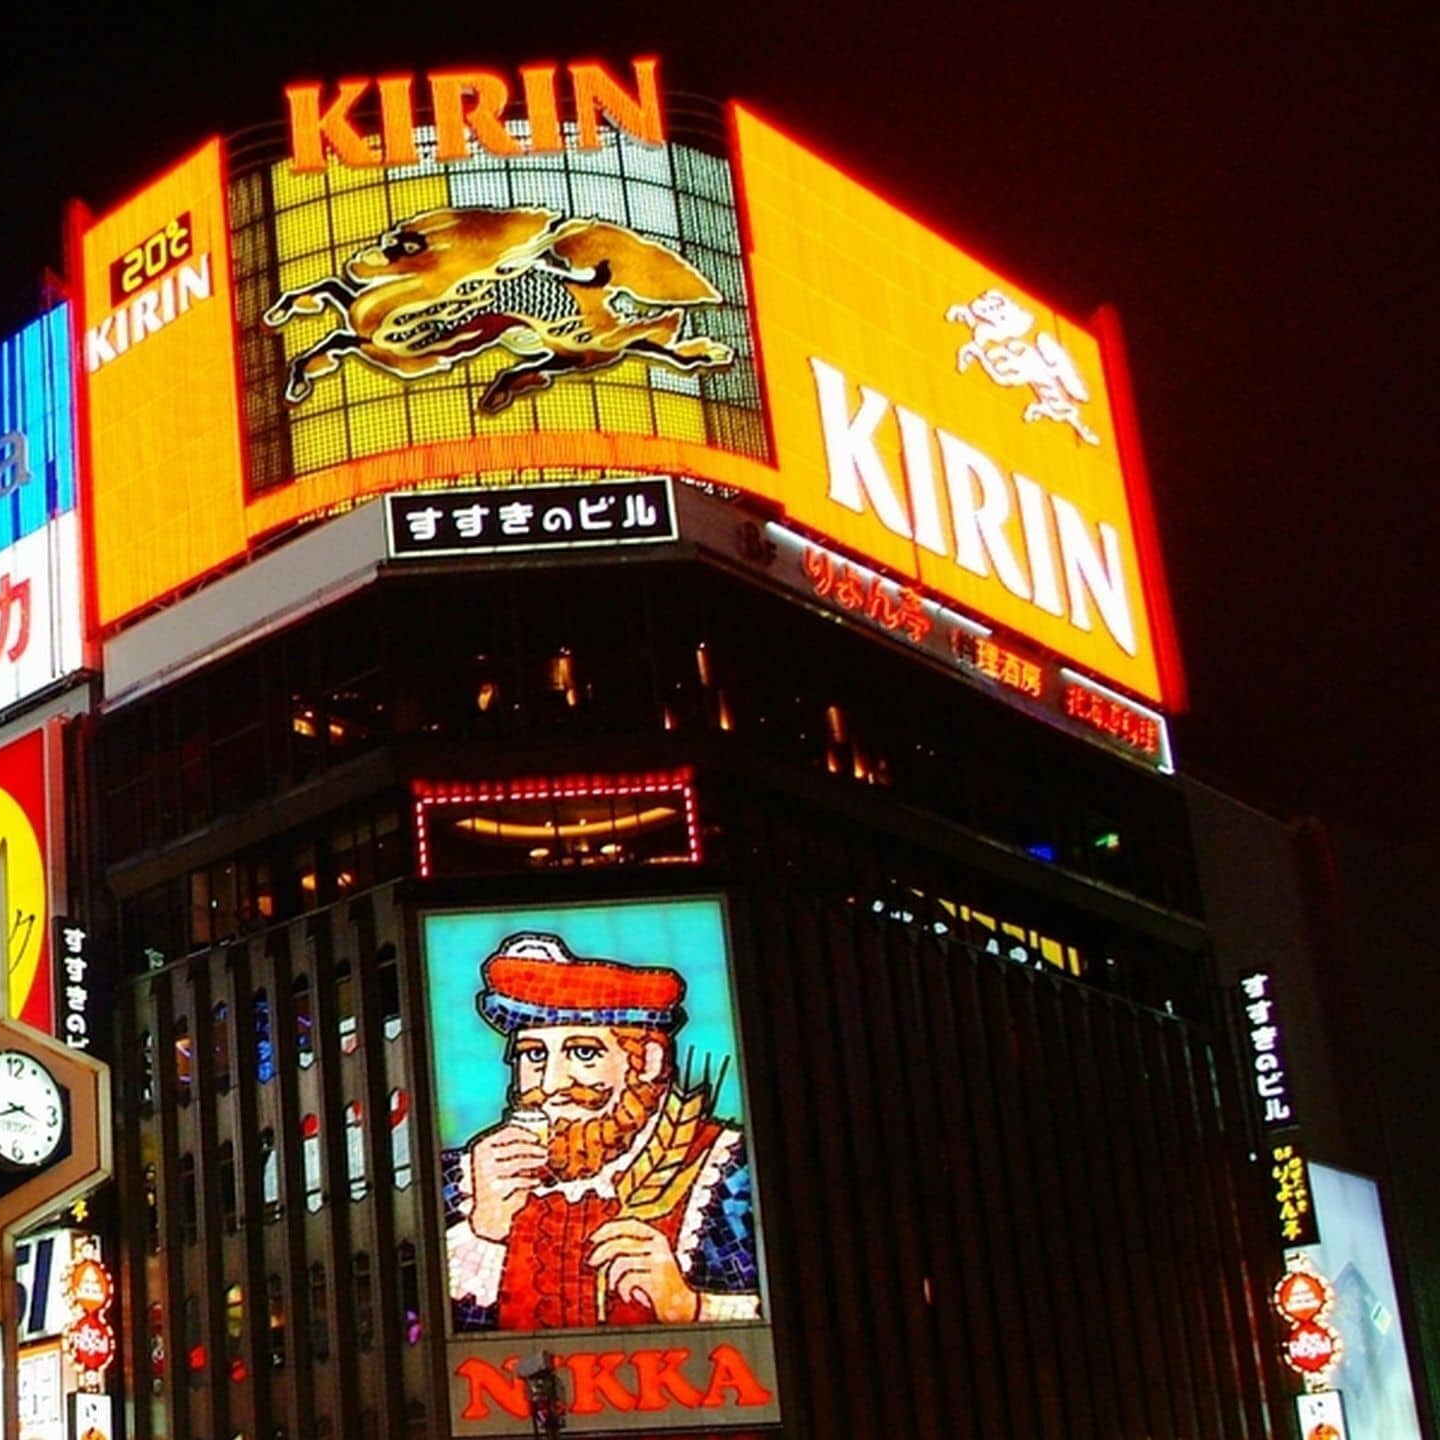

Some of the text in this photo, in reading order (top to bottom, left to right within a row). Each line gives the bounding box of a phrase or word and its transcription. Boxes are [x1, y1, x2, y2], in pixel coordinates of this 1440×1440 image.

[284, 58, 667, 173] KIRIN
[86, 252, 213, 374] KIRIN
[405, 493, 657, 541] すすきのビル
[809, 354, 1138, 659] KIRIN
[6, 1057, 25, 1080] 12
[1240, 972, 1291, 1123] すすきのビル
[46, 1106, 58, 1129] 3
[455, 1343, 773, 1422] NKKA
